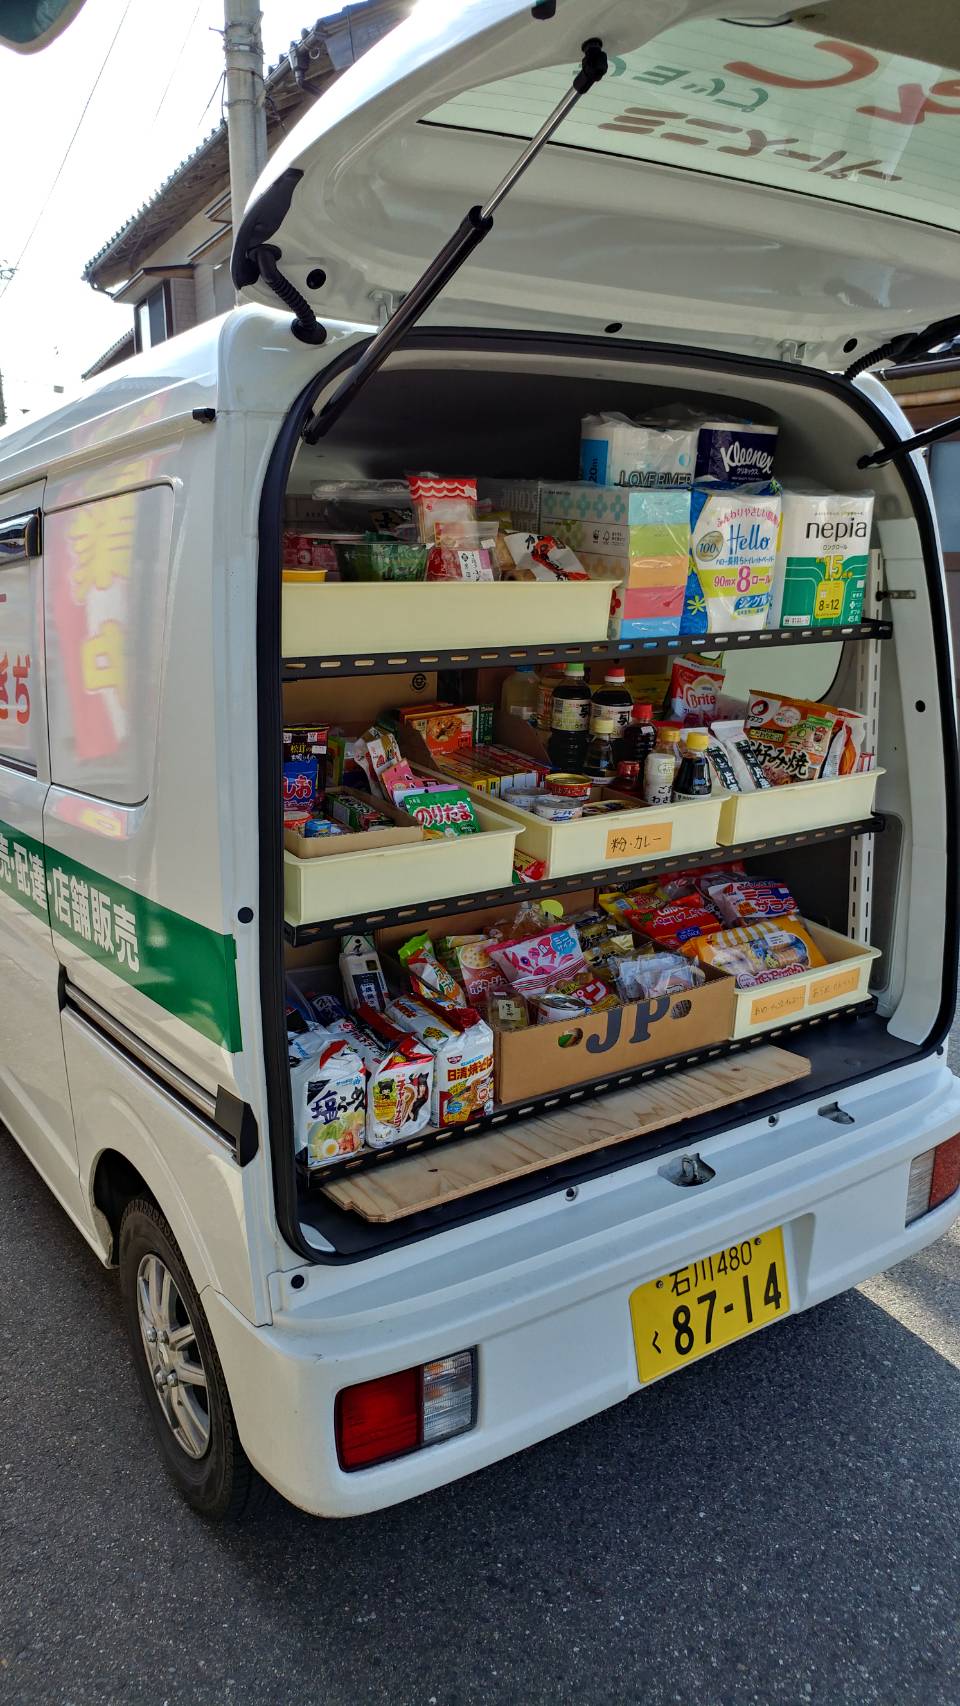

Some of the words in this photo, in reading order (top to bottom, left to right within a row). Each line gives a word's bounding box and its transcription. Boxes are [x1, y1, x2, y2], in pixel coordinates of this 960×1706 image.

[720, 440, 773, 475] Kleenex
[727, 523, 770, 555] Hello
[806, 517, 867, 542] nepia
[414, 802, 473, 826] のりたま
[611, 834, 661, 853] 粉・カレー
[448, 1056, 494, 1082] 日清焼そば
[652, 1330, 661, 1354] く
[672, 1261, 782, 1356] 87-14
